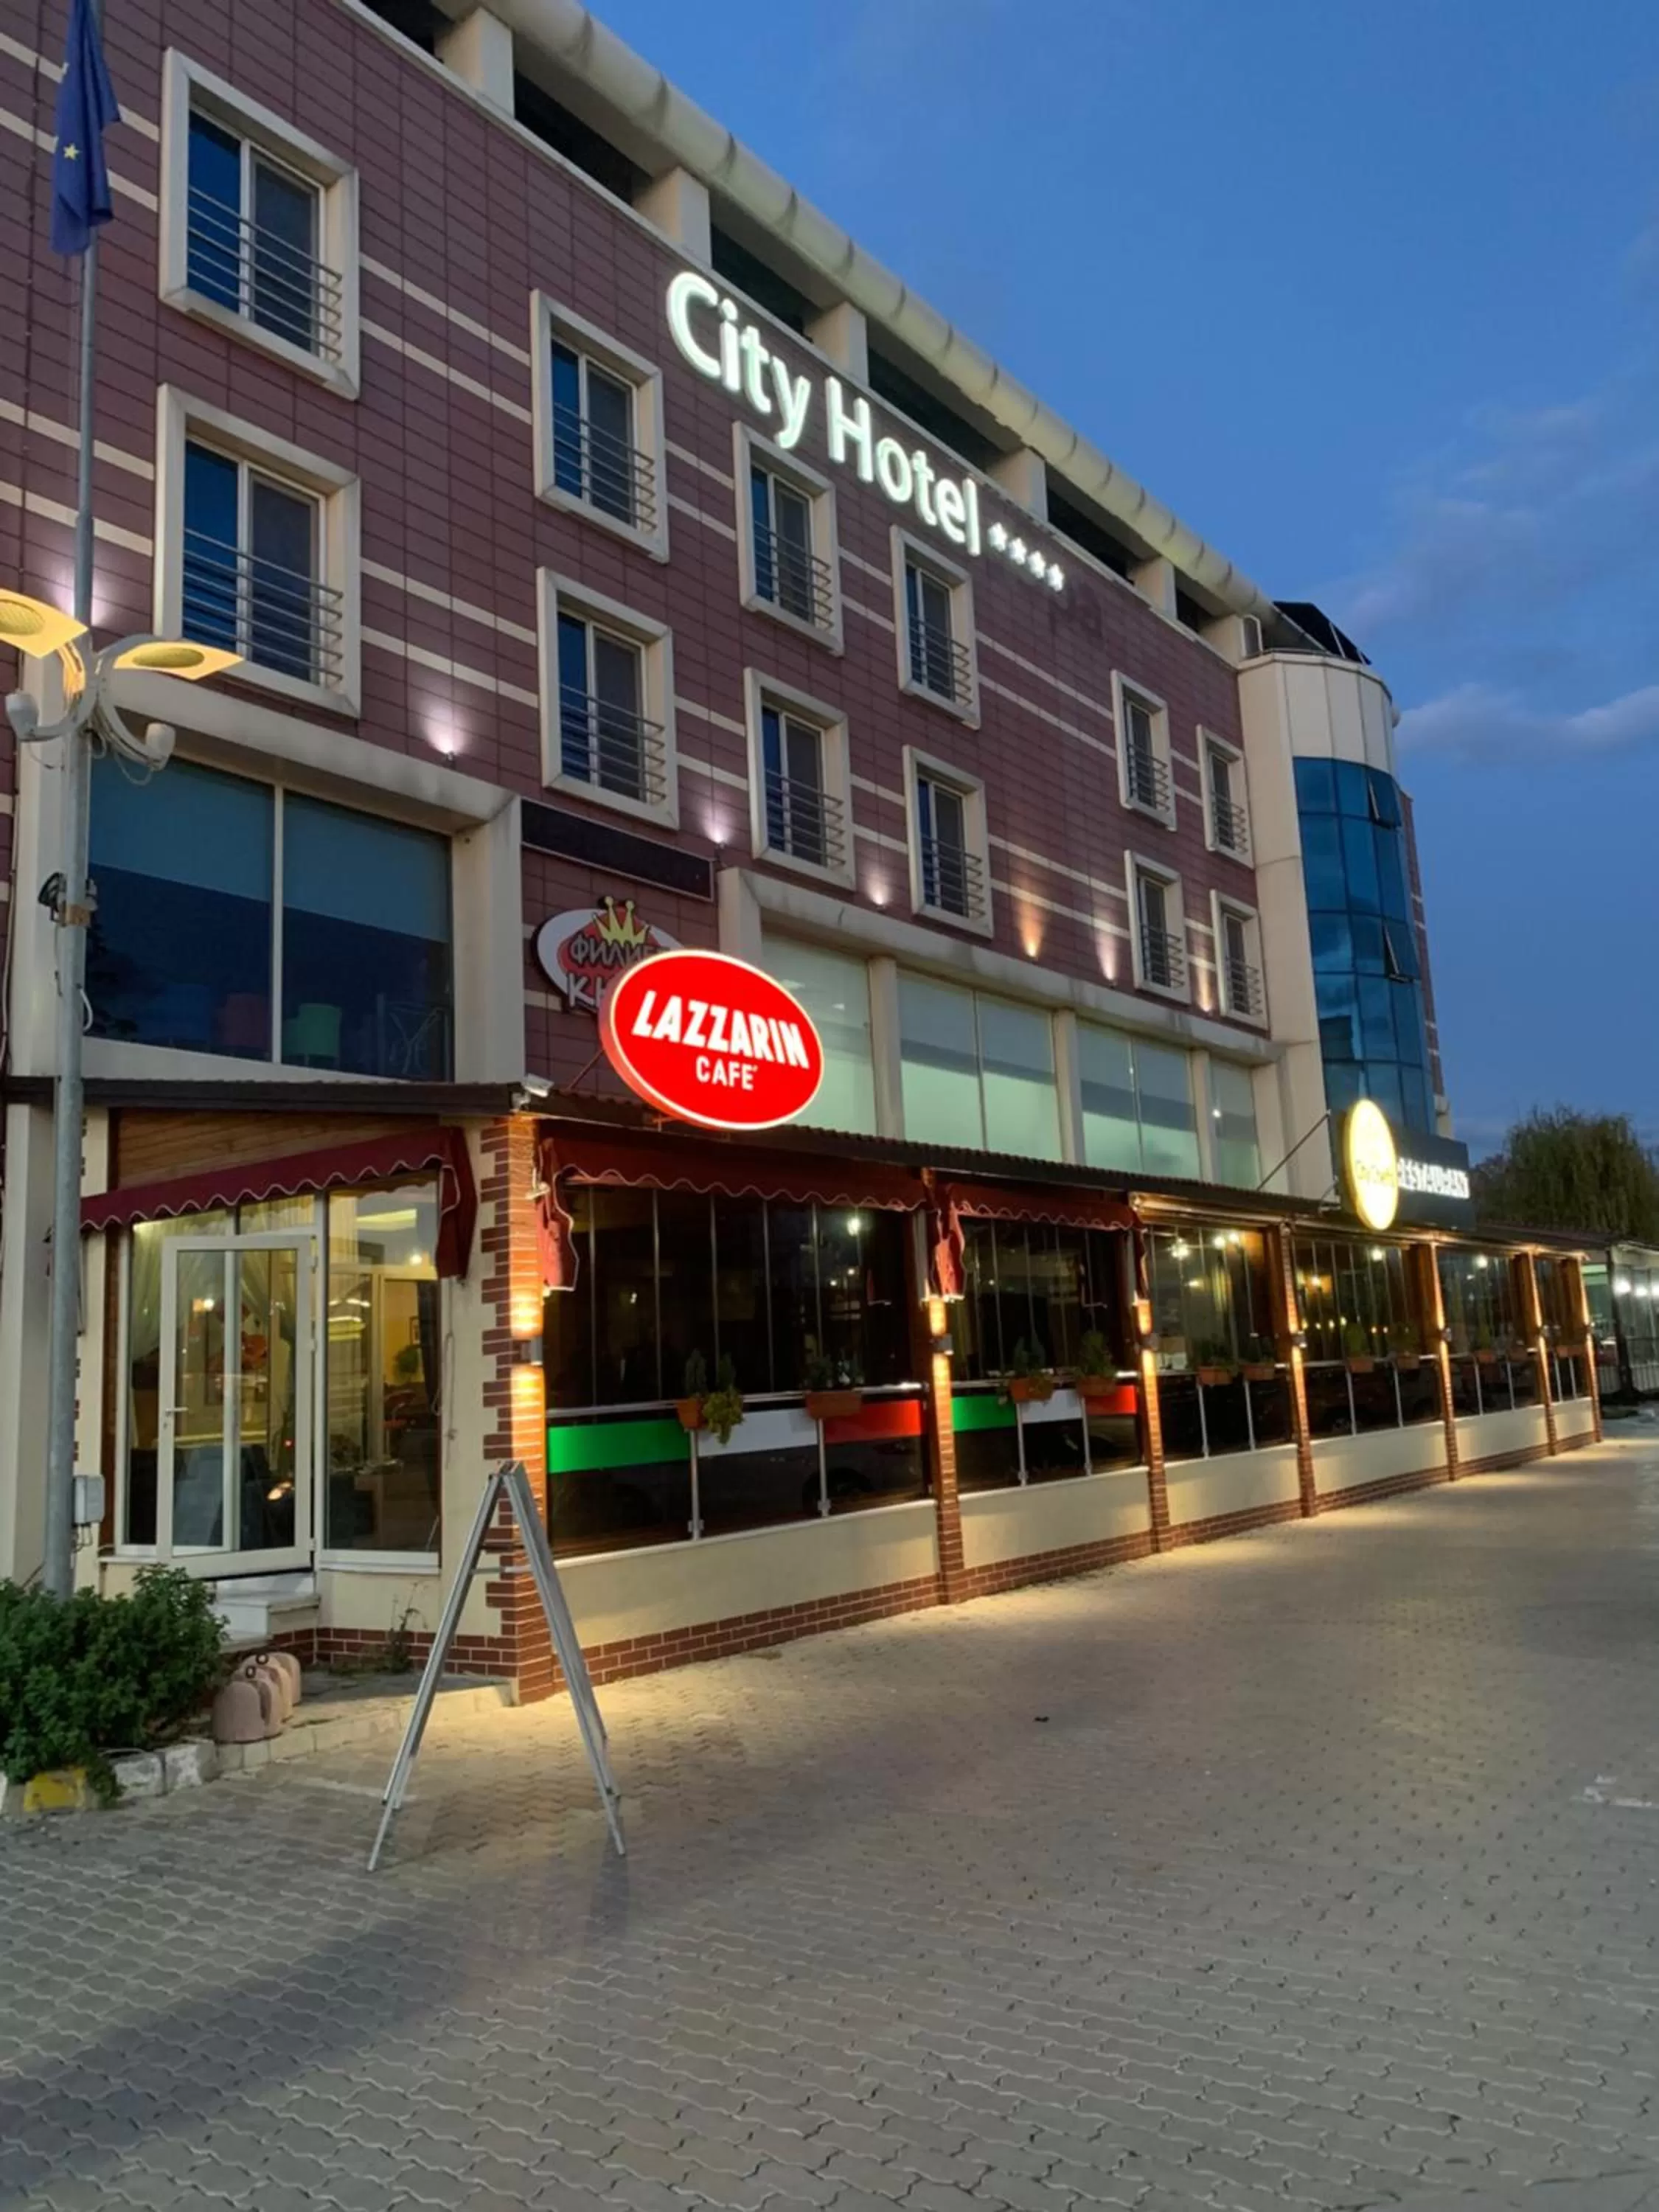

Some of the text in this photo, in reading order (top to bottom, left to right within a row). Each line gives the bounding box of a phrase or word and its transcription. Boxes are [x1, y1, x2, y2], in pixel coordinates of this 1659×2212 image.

[666, 271, 981, 556] City Hotel
[631, 990, 810, 1069] LAZZARIN
